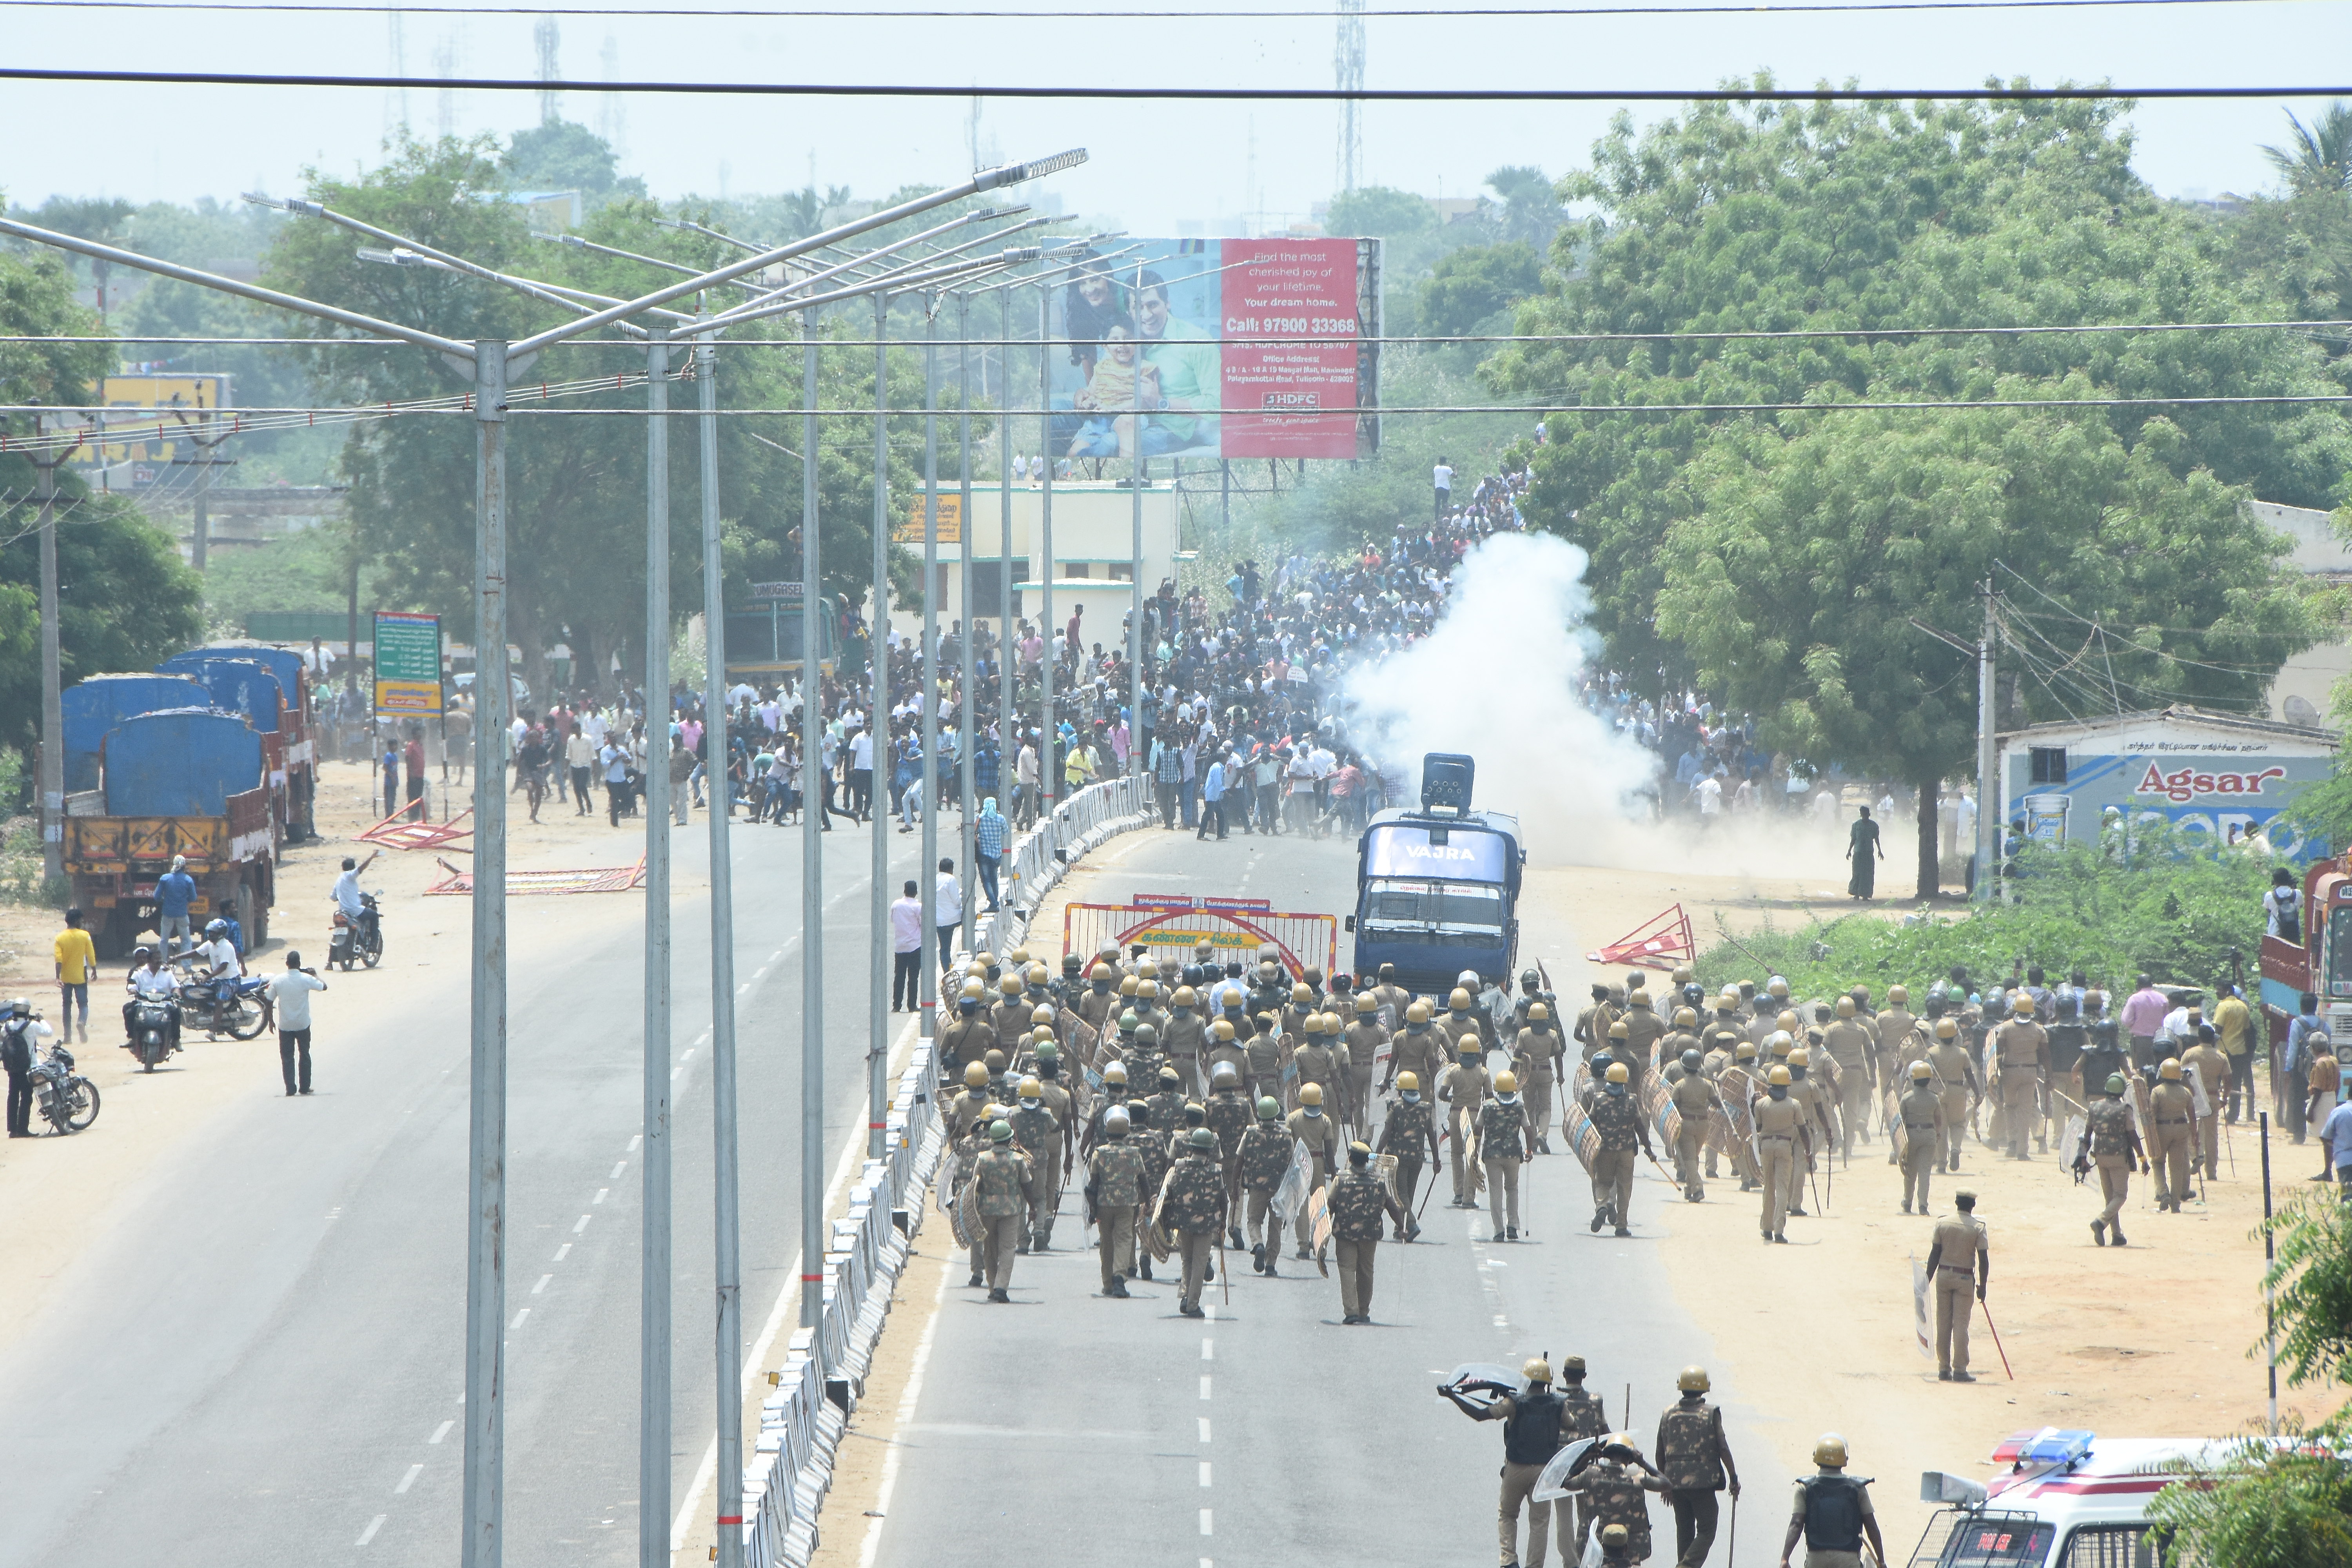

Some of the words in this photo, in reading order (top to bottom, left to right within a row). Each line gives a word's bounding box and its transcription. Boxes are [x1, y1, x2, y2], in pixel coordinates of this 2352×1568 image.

[1254, 252, 1277, 261] Find
[1281, 252, 1297, 261] the
[1300, 253, 1326, 262] most
[1249, 268, 1299, 277] cherished
[1303, 268, 1317, 278] joy
[1321, 268, 1332, 277] of
[1257, 284, 1279, 292] your
[1283, 283, 1323, 291] lifetime.
[1245, 298, 1267, 307] Your
[1270, 298, 1303, 307] dream
[1307, 298, 1338, 307] home.
[1227, 318, 1259, 332] Call:
[1263, 318, 1307, 332] 97900
[1312, 318, 1355, 333] 33368
[1276, 375, 1293, 383] Road,
[1277, 394, 1316, 405] HDFC
[2137, 759, 2284, 802] Agsar
[1406, 846, 1475, 861] VAJRA
